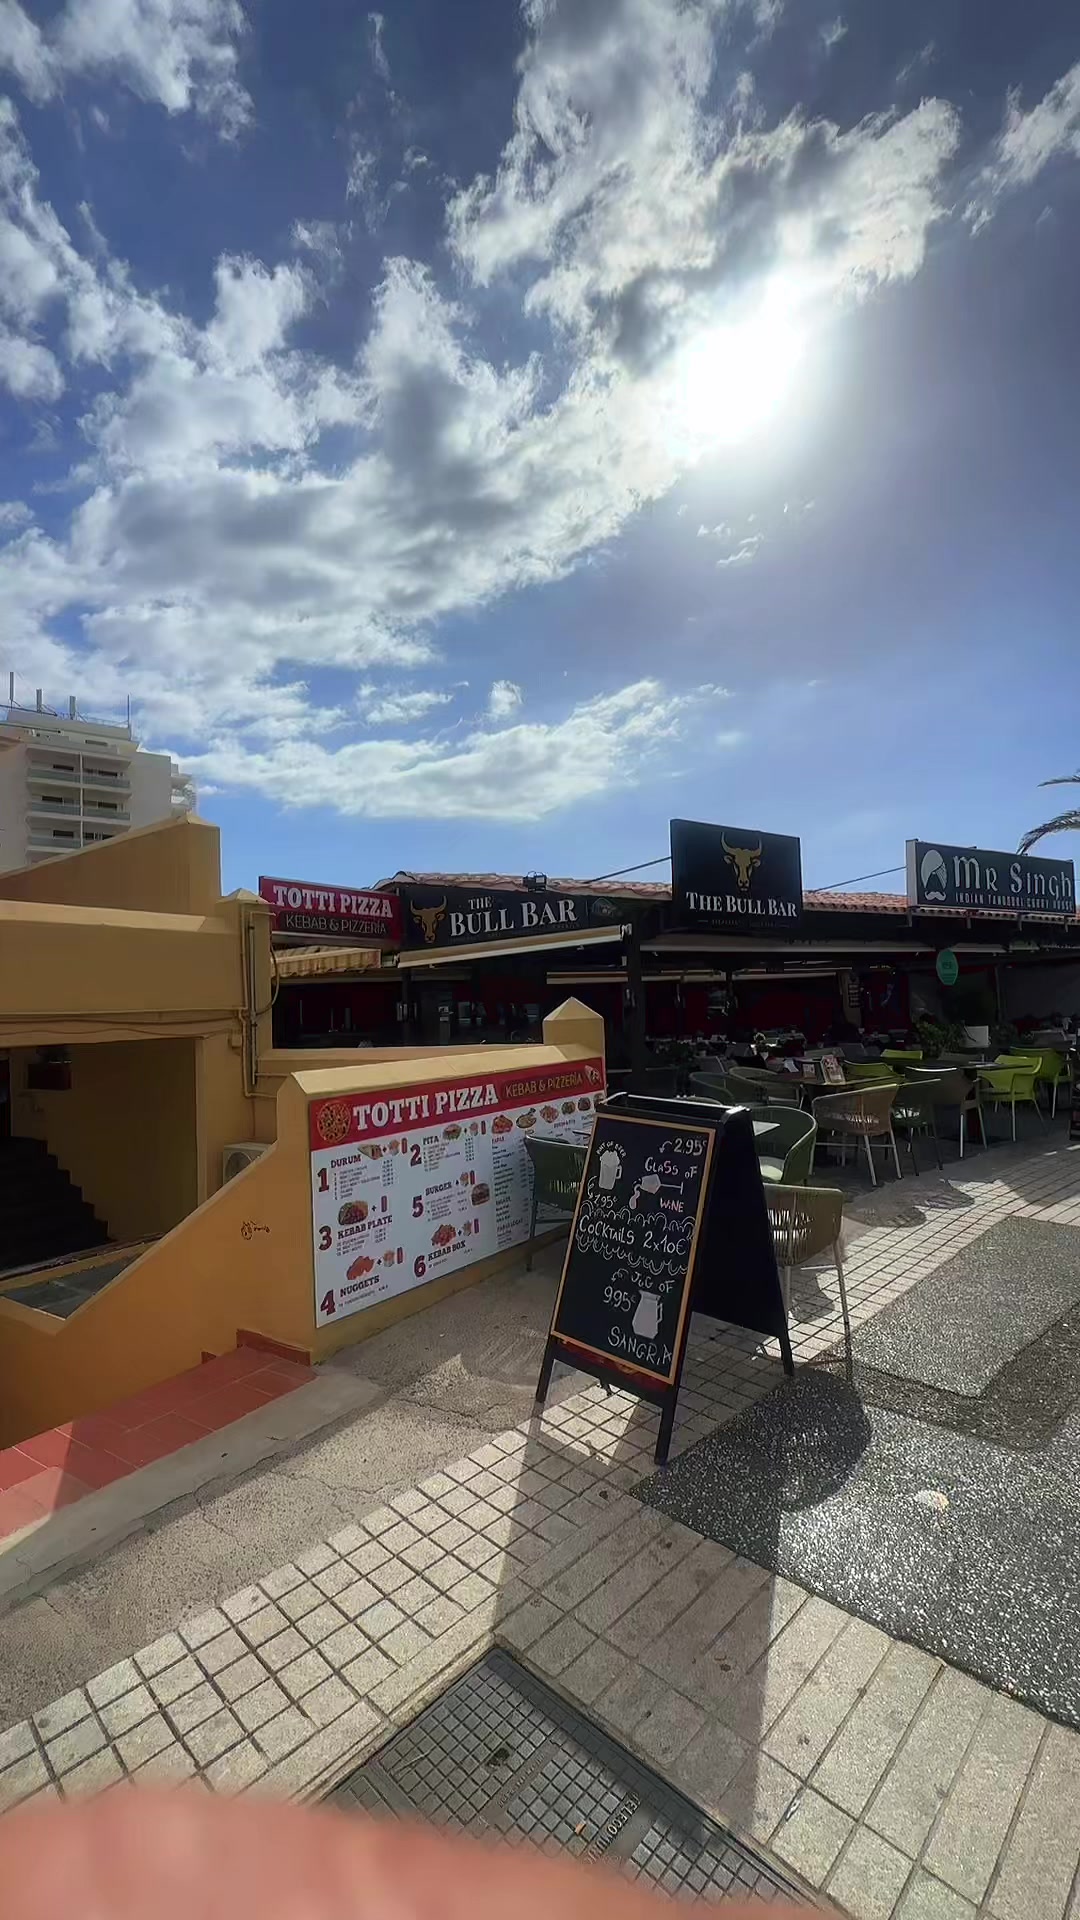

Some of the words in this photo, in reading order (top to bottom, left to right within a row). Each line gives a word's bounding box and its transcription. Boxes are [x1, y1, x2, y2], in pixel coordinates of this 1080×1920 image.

[273, 885, 336, 912] TOTTI
[340, 894, 393, 918] PIZZA
[449, 909, 515, 937] BULL
[520, 899, 580, 928] BAR
[467, 896, 495, 910] THE
[684, 892, 722, 912] THE
[726, 895, 766, 915] BULL
[767, 898, 798, 917] BAR
[286, 914, 327, 930] KEBAB
[329, 918, 340, 932] &
[353, 1094, 430, 1131] TOTTI
[435, 1083, 498, 1115] PIZZA
[505, 1082, 537, 1097] KEBAB
[538, 1080, 547, 1092] &
[410, 1144, 422, 1167] 2
[423, 1135, 439, 1145] PITA
[317, 1168, 329, 1192] 1
[331, 1154, 361, 1168] DURUM
[412, 1195, 424, 1218] 5
[425, 1181, 452, 1197] BURGER
[319, 1226, 332, 1251] 3
[338, 1223, 366, 1239] KEBAB
[367, 1215, 392, 1230] PLATE
[414, 1255, 426, 1278] 6
[428, 1246, 451, 1262] KEBAB
[452, 1240, 466, 1254] BOX
[320, 1289, 336, 1316] 4
[340, 1275, 379, 1298] NUGGETS
